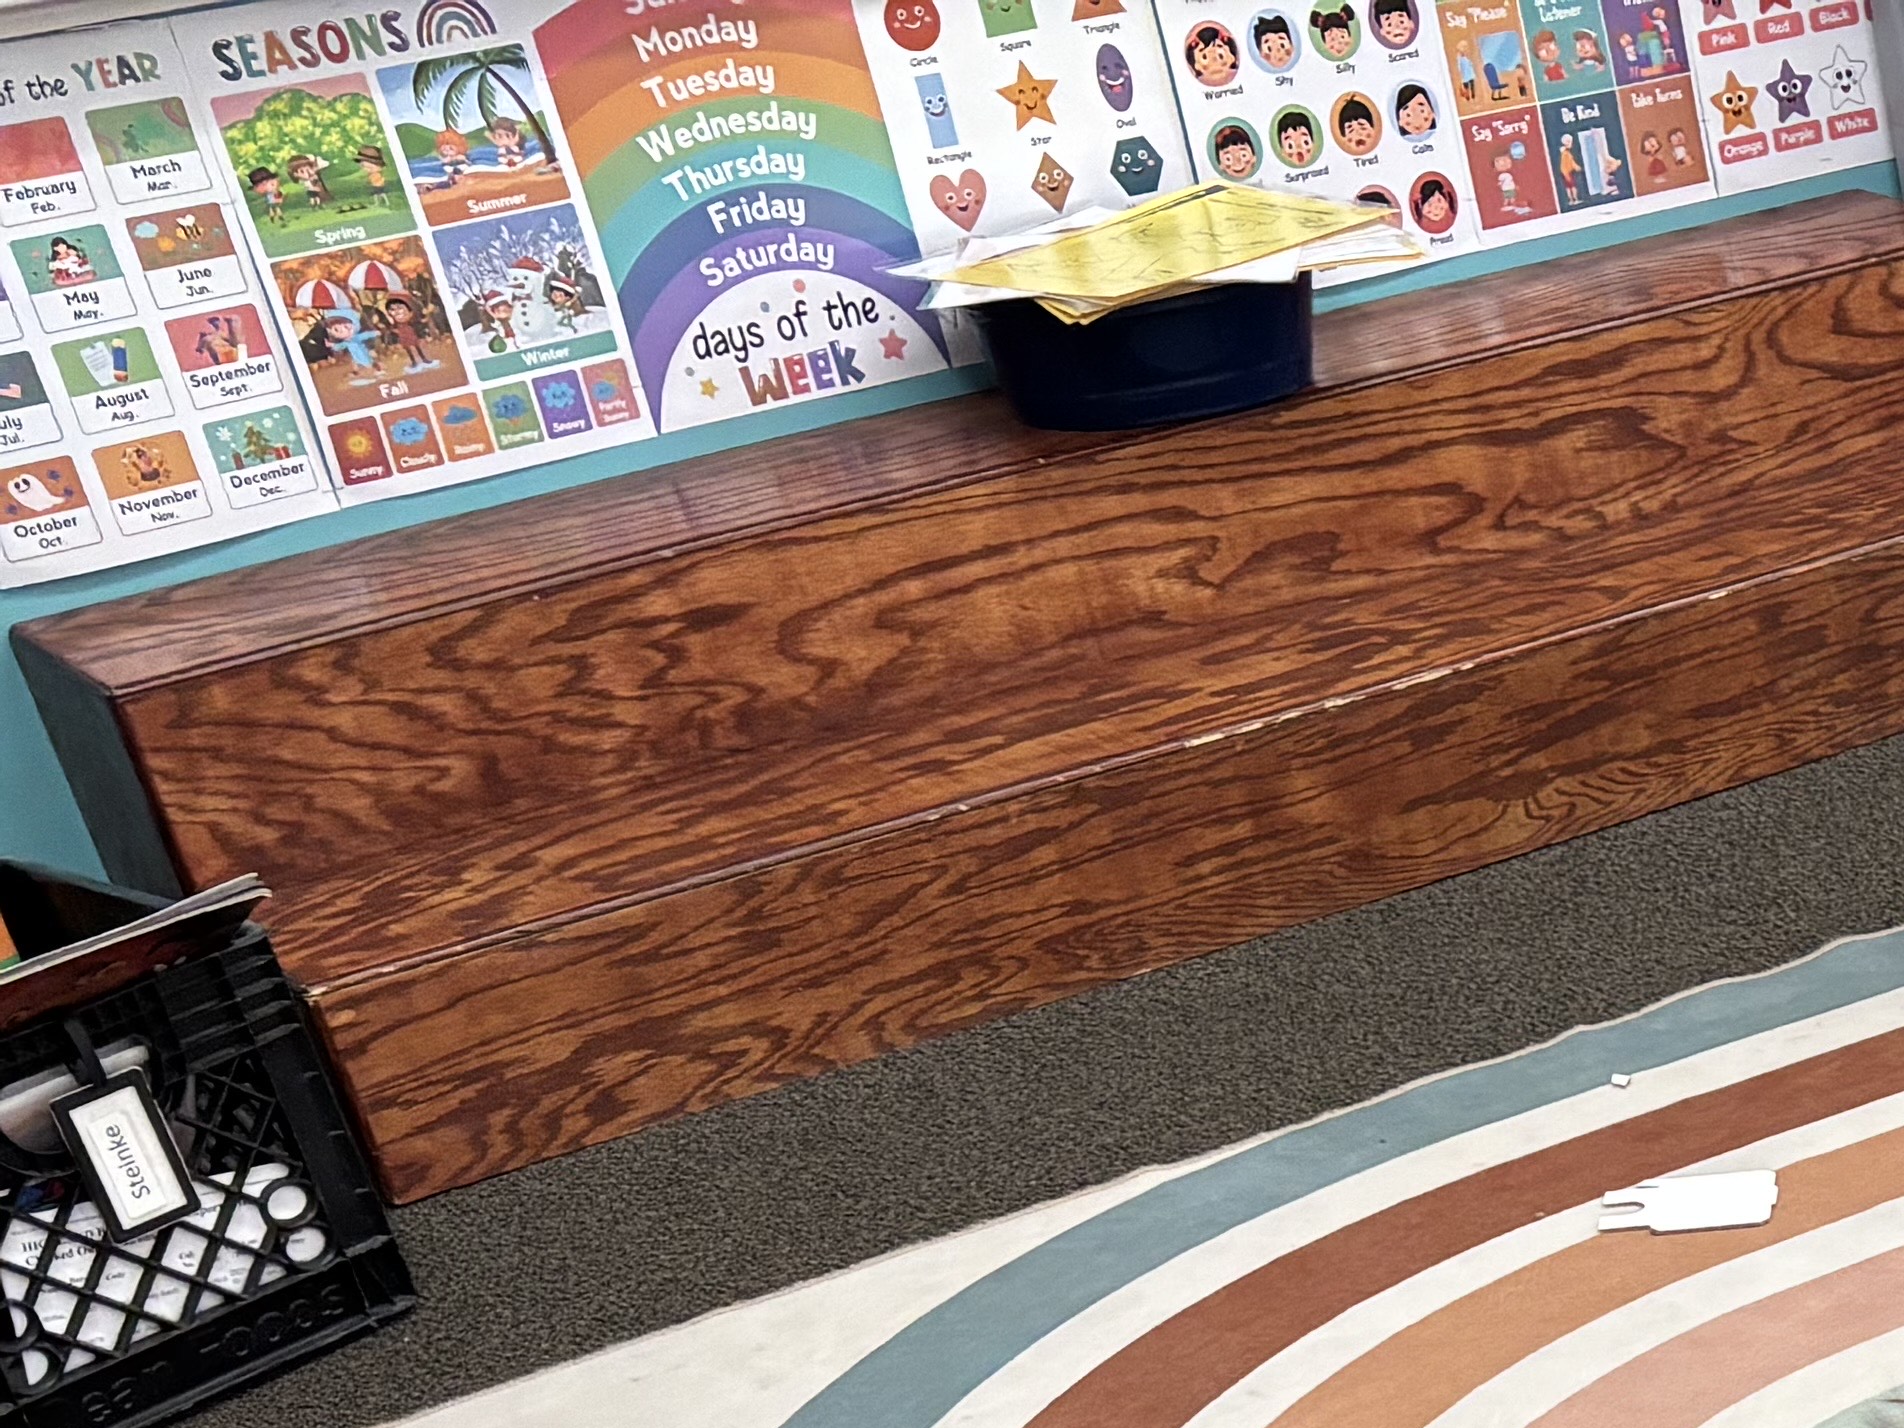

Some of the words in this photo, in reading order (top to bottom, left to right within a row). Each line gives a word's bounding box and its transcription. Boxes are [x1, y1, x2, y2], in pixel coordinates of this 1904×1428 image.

[1445, 12, 1468, 28] Say
[1819, 9, 1851, 24] Black
[1083, 21, 1120, 34] Triangle
[1767, 20, 1790, 34] Red
[211, 9, 411, 82] SEASONS
[631, 13, 760, 63] Monday
[1000, 39, 1032, 52] Square
[1711, 31, 1737, 47] Pink
[909, 55, 938, 68] Circle
[1388, 49, 1419, 63] Scared
[24, 74, 69, 101] the
[71, 52, 162, 92] YEAR
[1335, 63, 1356, 75] Silly
[640, 58, 776, 108] Tuesday
[1275, 75, 1294, 87] Shy
[1203, 84, 1244, 100] Worried
[1561, 107, 1577, 124] Be
[1576, 103, 1601, 120] Kind
[1116, 117, 1137, 129] Oval
[1834, 114, 1871, 133] White
[635, 101, 817, 163] Wednesday
[1471, 123, 1493, 142] Say
[1780, 129, 1817, 146] Purple
[1031, 136, 1052, 146] Star
[1412, 143, 1434, 155] Calm
[1723, 140, 1764, 158] Orange
[926, 150, 972, 165] Rectangle
[1353, 155, 1379, 169] Tired
[130, 159, 182, 179] March
[661, 144, 806, 201] Thursday
[1284, 165, 1330, 184] Surprised
[3, 179, 77, 202] February
[31, 202, 61, 214] Feb.
[466, 191, 527, 214] Summer
[706, 191, 806, 234] Friday
[314, 224, 366, 245] Spring
[699, 233, 835, 287] Saturday
[177, 268, 212, 283] June
[63, 290, 100, 306] May
[692, 322, 765, 363] days
[777, 300, 808, 341] of
[822, 291, 880, 331] the
[520, 346, 570, 366] Winter
[189, 359, 271, 388] September
[94, 388, 150, 409] August
[220, 384, 252, 398] Sept.
[379, 381, 409, 399] Fall
[0, 415, 23, 431] uly
[111, 410, 140, 422] Aug.
[553, 418, 585, 434] Snowy
[400, 453, 438, 468] Cloudy
[229, 463, 305, 489] December
[350, 464, 384, 480] Sunny
[118, 489, 198, 515] November
[150, 511, 180, 523] Nov.
[13, 516, 78, 538] October
[105, 1123, 151, 1200] Steinke
